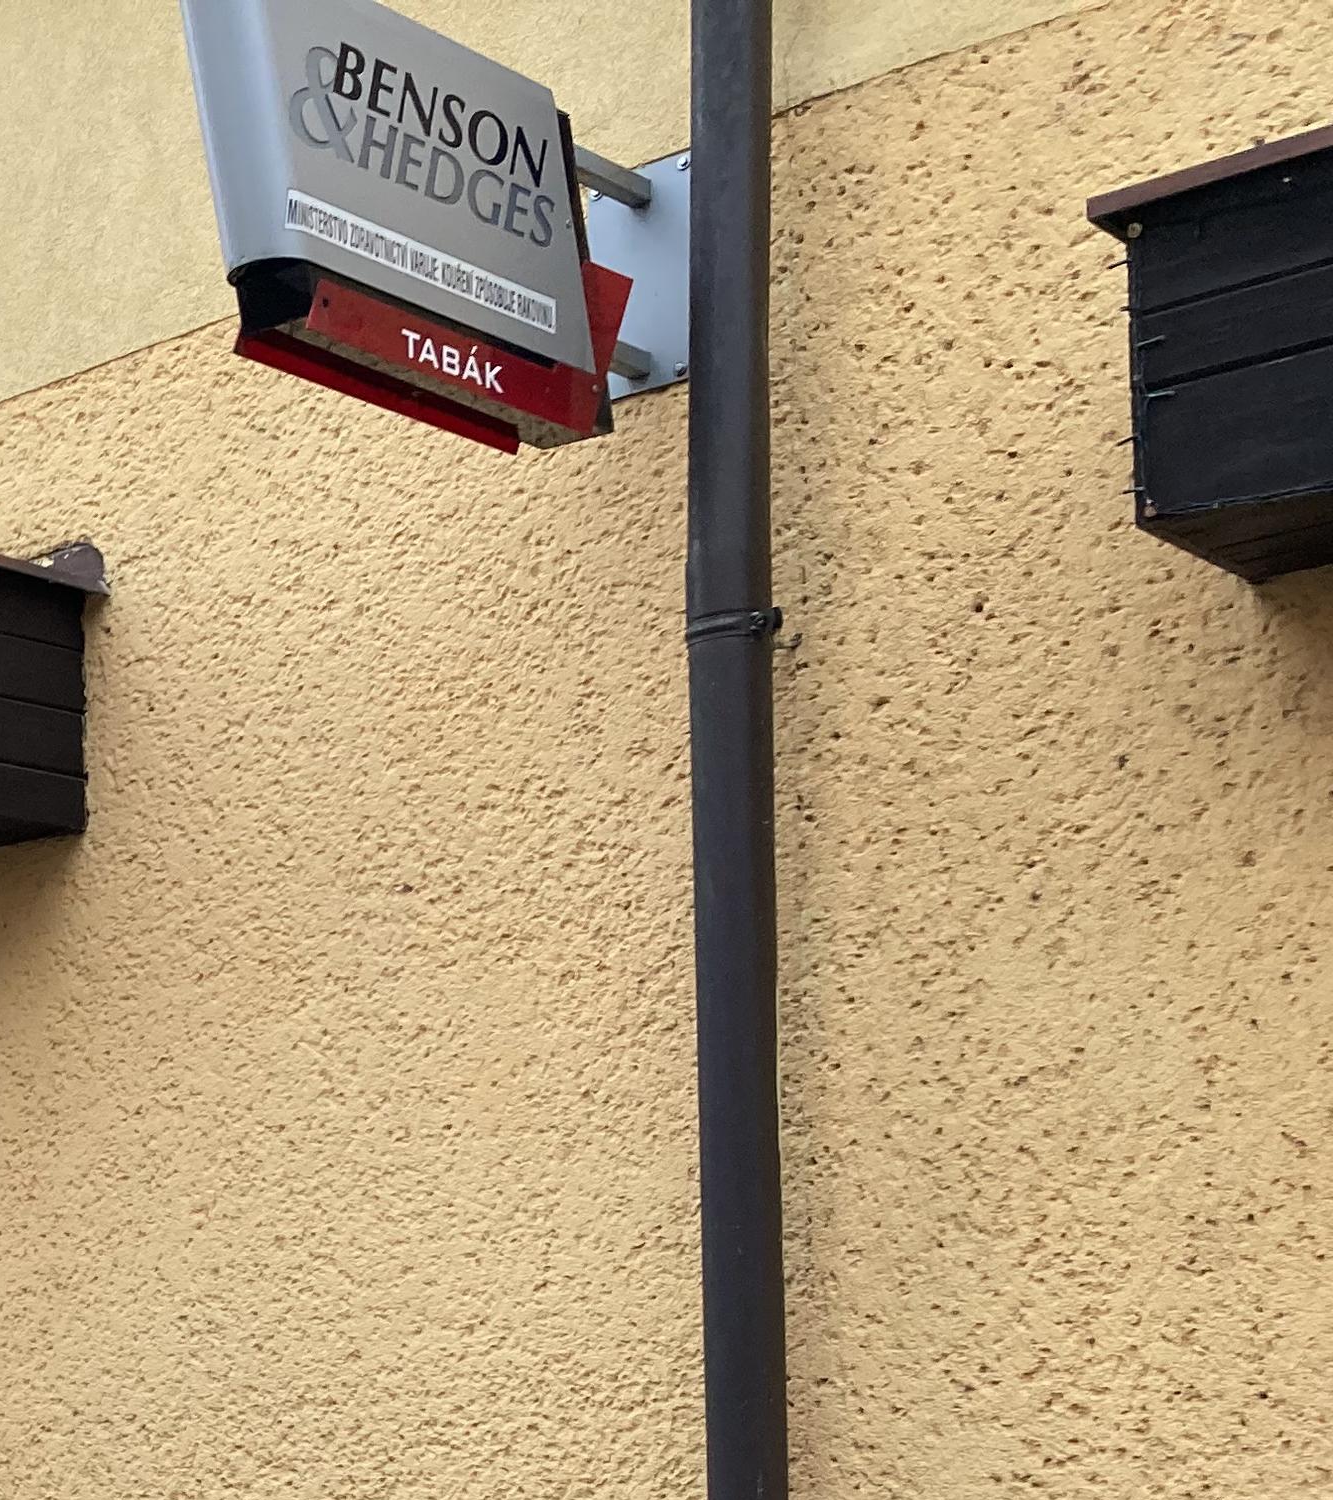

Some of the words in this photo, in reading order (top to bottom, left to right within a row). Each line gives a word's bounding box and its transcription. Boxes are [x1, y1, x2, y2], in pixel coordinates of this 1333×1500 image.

[334, 42, 548, 188] BENSON
[358, 116, 555, 248] HEDGES
[401, 328, 504, 393] TABÁK
